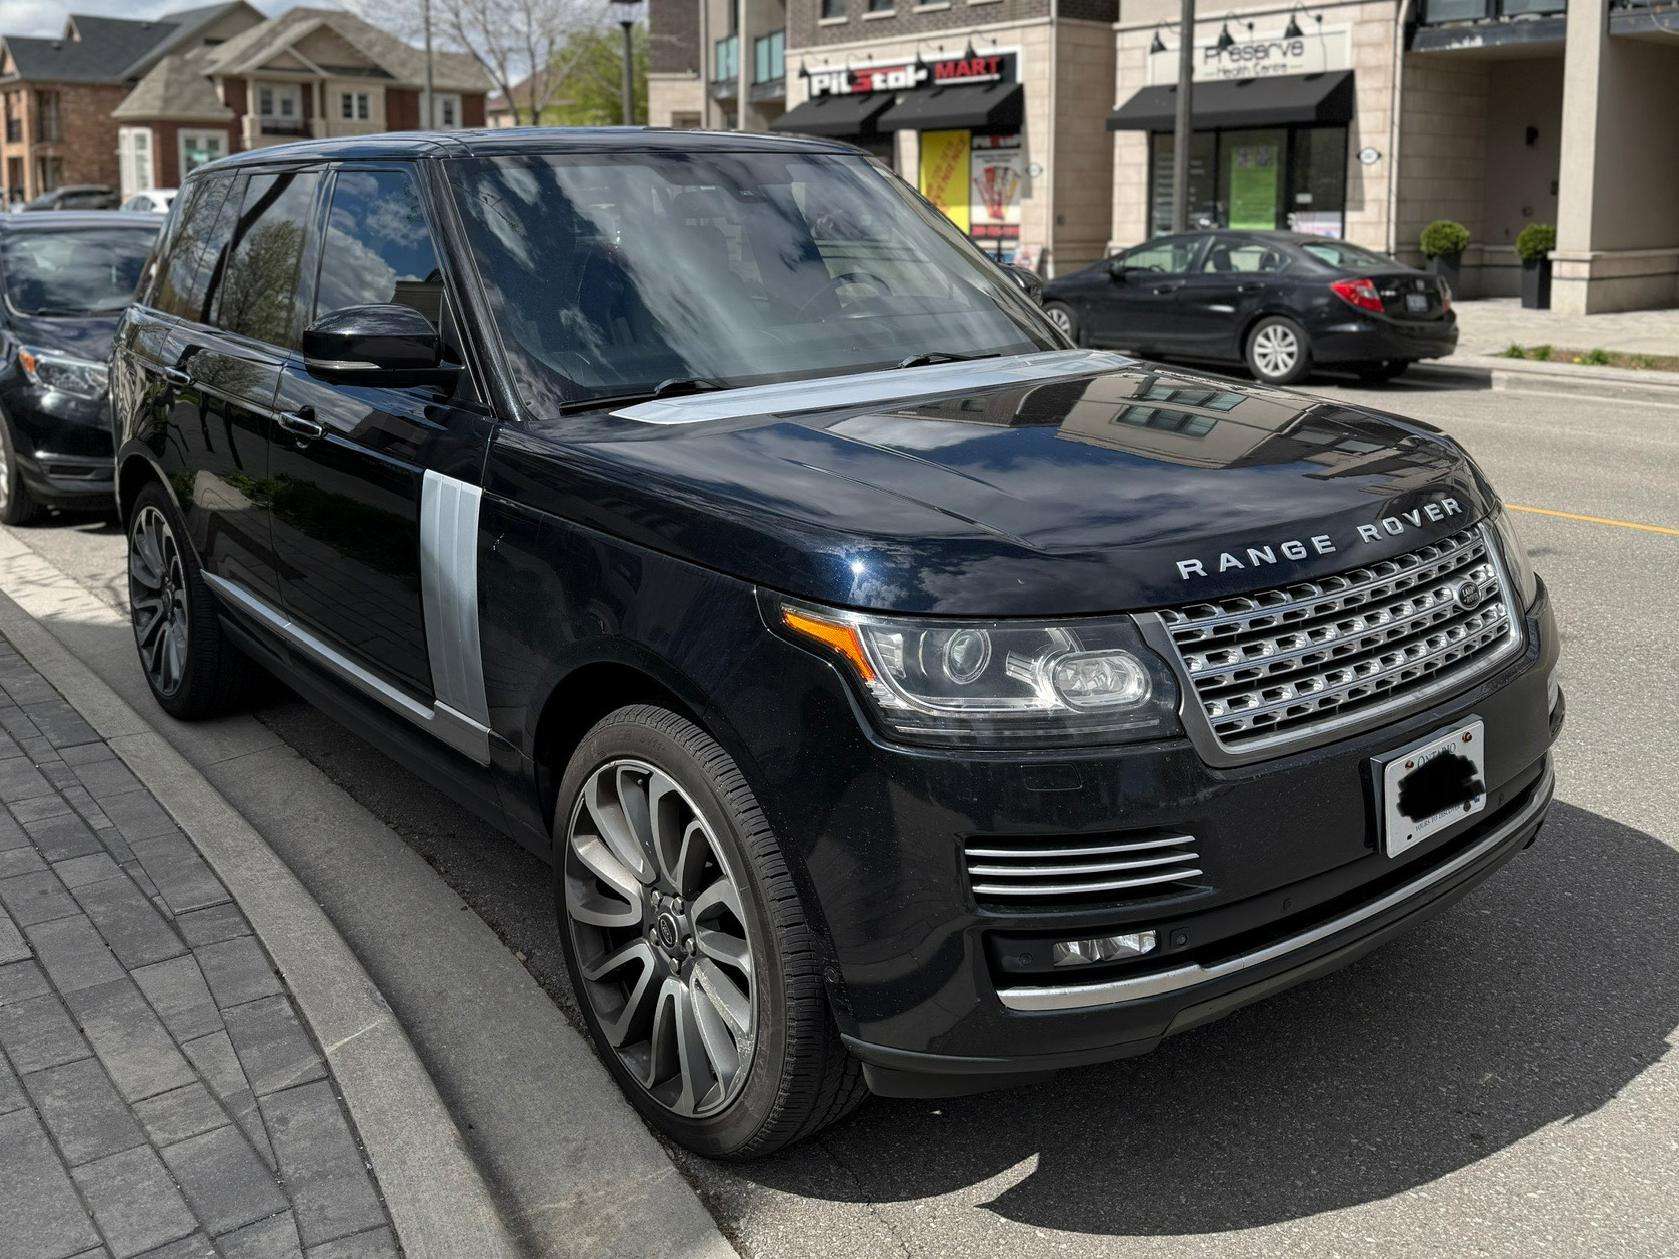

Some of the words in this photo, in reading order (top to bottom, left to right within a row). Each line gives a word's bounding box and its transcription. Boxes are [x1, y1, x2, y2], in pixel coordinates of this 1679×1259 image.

[1204, 40, 1304, 65] Preserve
[934, 57, 1000, 78] MART
[1175, 533, 1337, 580] RANGE
[1356, 497, 1464, 545] ROVER
